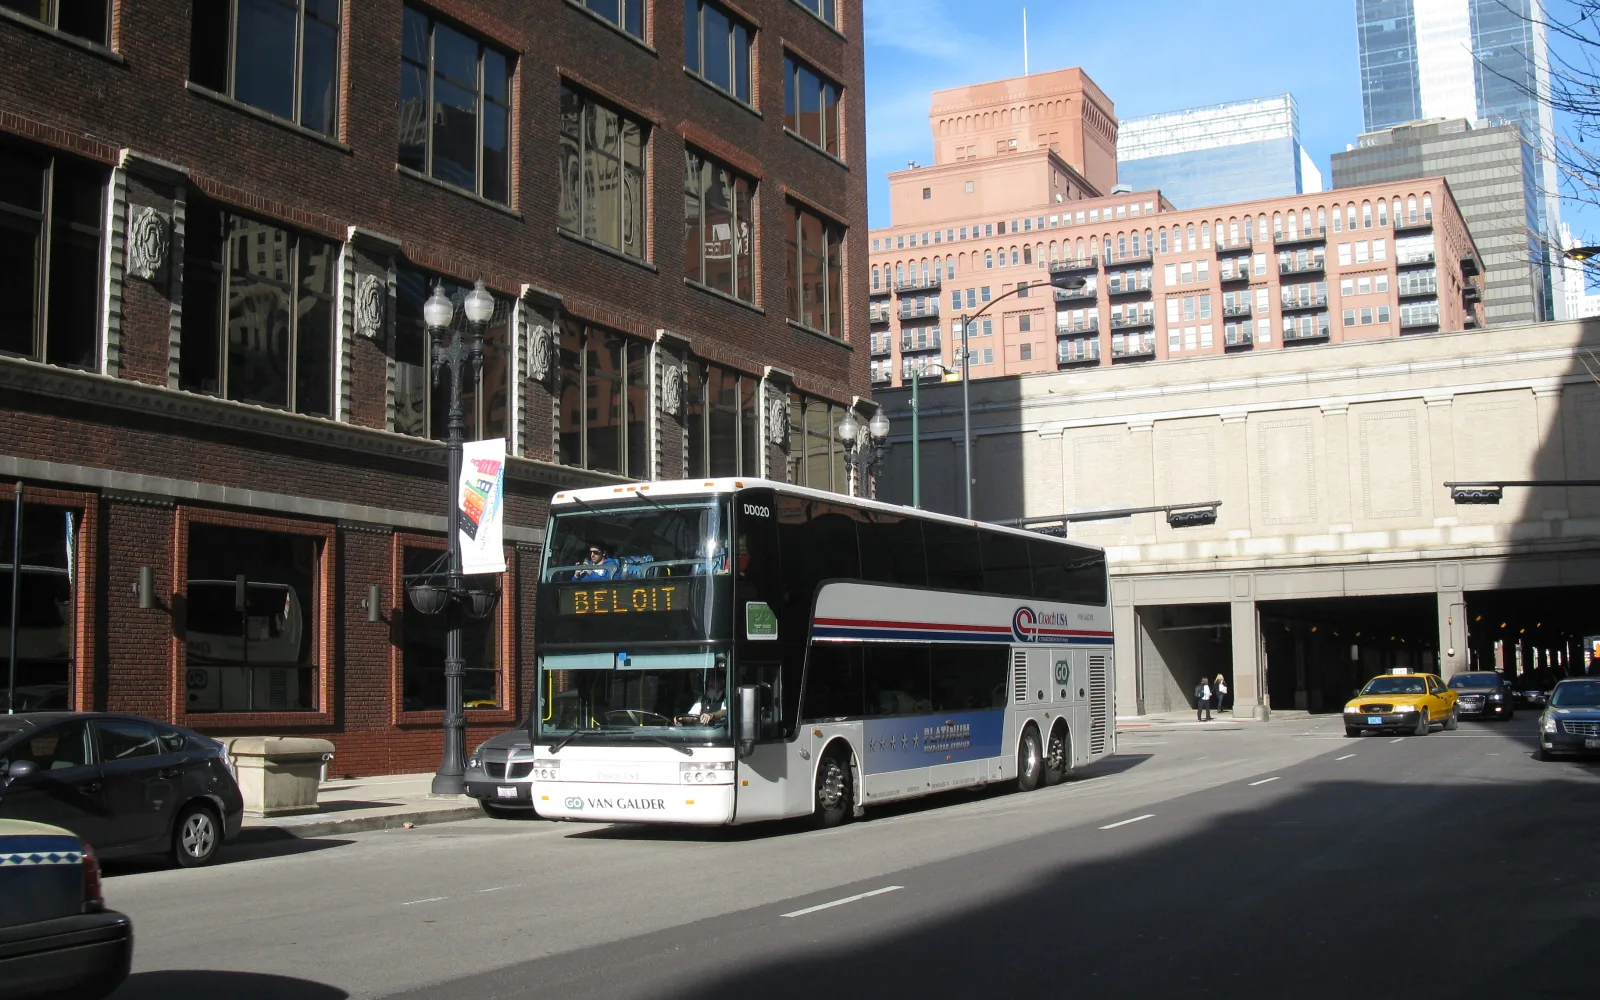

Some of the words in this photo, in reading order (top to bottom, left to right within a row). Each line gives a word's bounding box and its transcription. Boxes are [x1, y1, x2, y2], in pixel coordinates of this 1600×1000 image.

[743, 503, 770, 518] DD020
[574, 587, 676, 614] BELOIT
[1038, 611, 1056, 626] Coach
[1056, 612, 1068, 627] USA
[1055, 662, 1068, 682] GO
[565, 796, 582, 809] GO
[587, 798, 613, 809] VAN
[617, 798, 666, 810] GALDER
